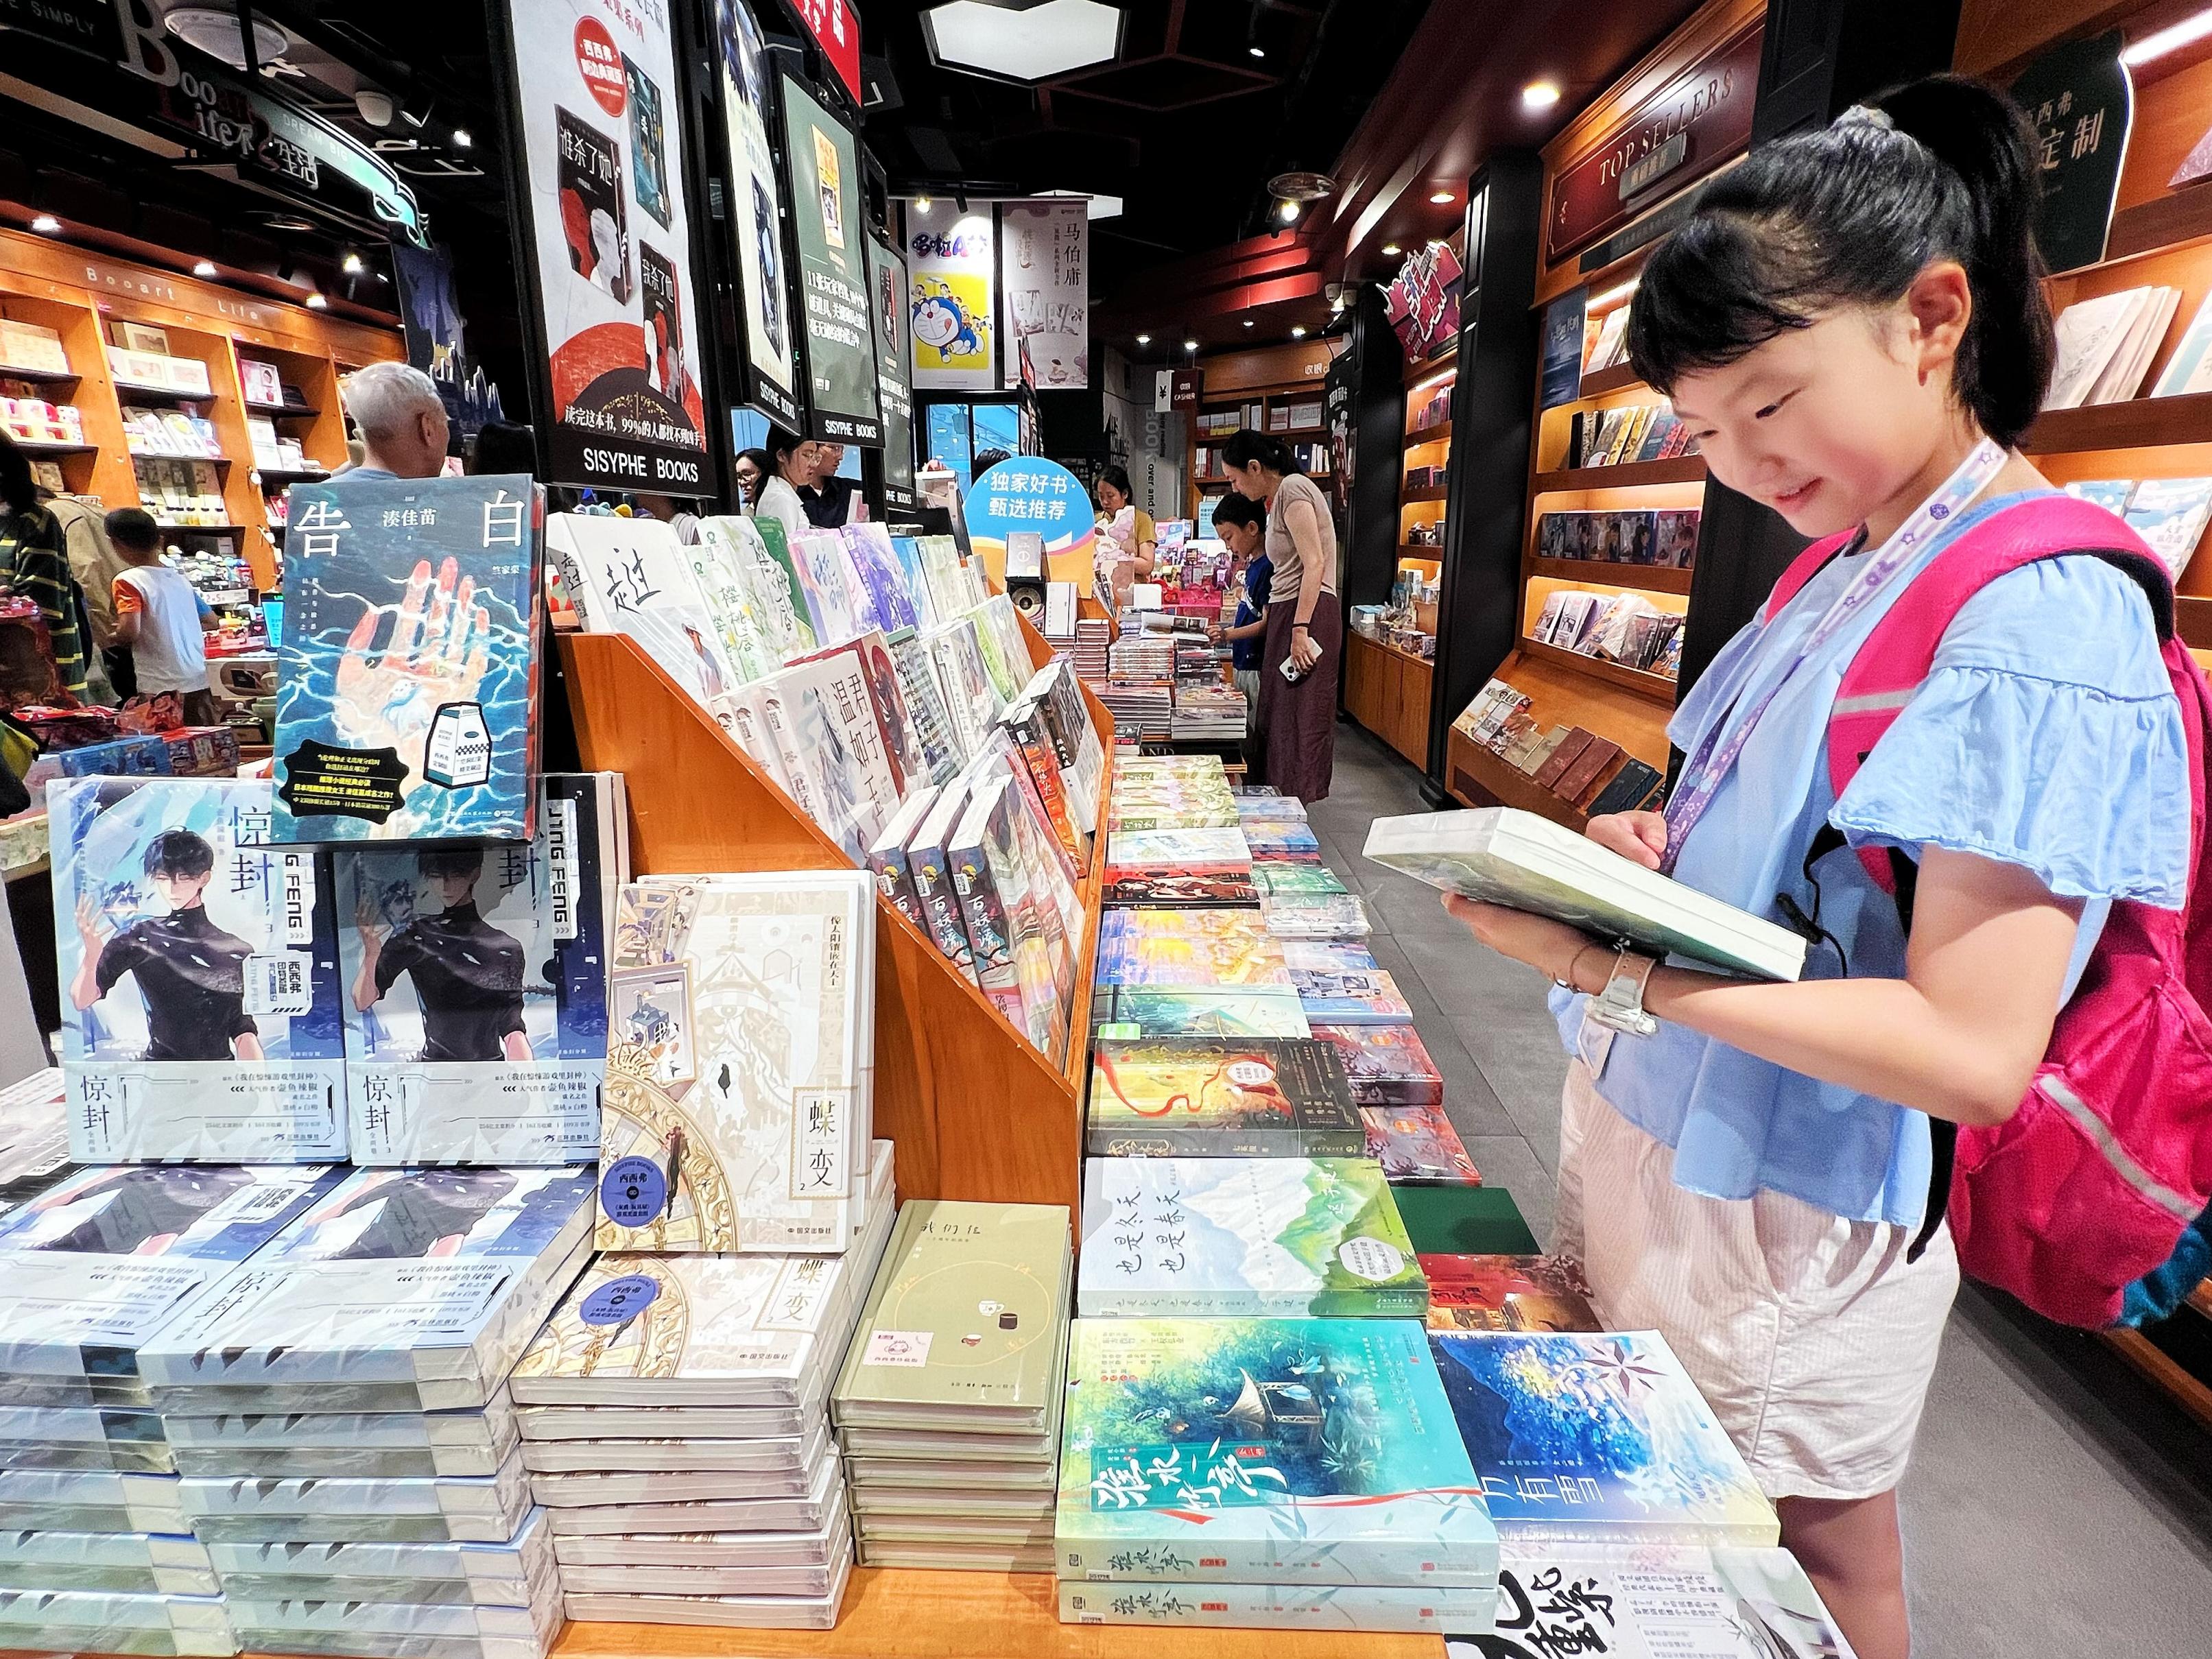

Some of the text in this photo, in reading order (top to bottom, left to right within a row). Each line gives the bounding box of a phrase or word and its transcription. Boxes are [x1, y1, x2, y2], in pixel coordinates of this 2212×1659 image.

[583, 38, 613, 62] 西西弗
[1599, 68, 1734, 186] TOP SELLERS
[2025, 90, 2073, 127] 西弗
[282, 114, 348, 162] DREAM BIG
[2038, 107, 2105, 170] 定制
[1063, 222, 1082, 287] 马伯庸
[86, 267, 176, 300] Booart
[1174, 392, 1196, 401] CASHIER
[825, 419, 877, 439] SISYPHE BOOKS
[584, 448, 699, 483] SISYPHE BOOKS
[990, 470, 1069, 497] 独家好书
[481, 488, 526, 549] 白
[897, 491, 912, 505] BOOKS
[987, 497, 1067, 520] 甄选推荐
[293, 500, 353, 559] 告
[548, 809, 569, 924] JING FENG
[286, 874, 302, 929] FENG
[809, 1100, 835, 1189] 蝶变
[1154, 1189, 1187, 1275] 也是春天
